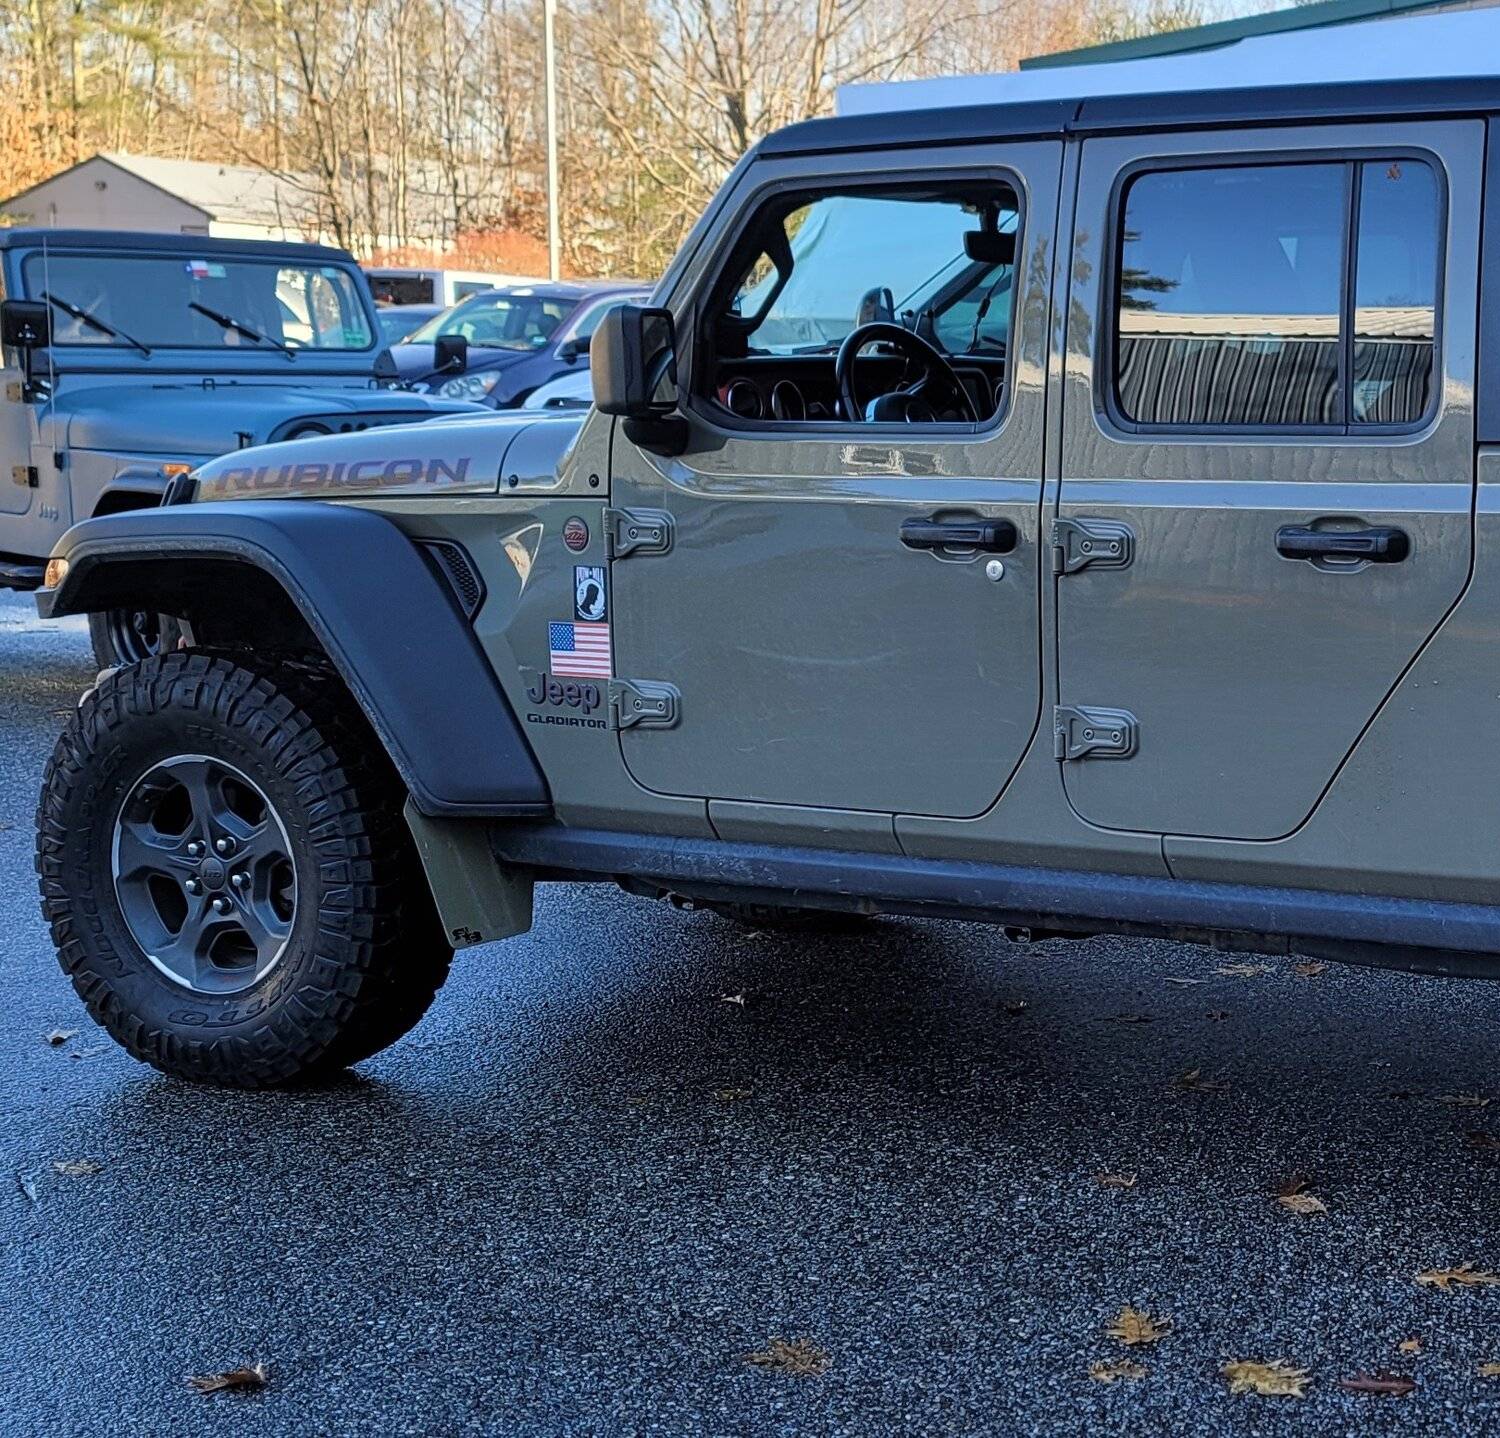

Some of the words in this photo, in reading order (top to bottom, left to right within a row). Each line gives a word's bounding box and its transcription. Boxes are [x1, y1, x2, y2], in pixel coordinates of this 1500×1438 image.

[215, 457, 471, 490] RUBICON
[527, 672, 600, 714] Jeep
[527, 713, 608, 730] GLADIATOR
